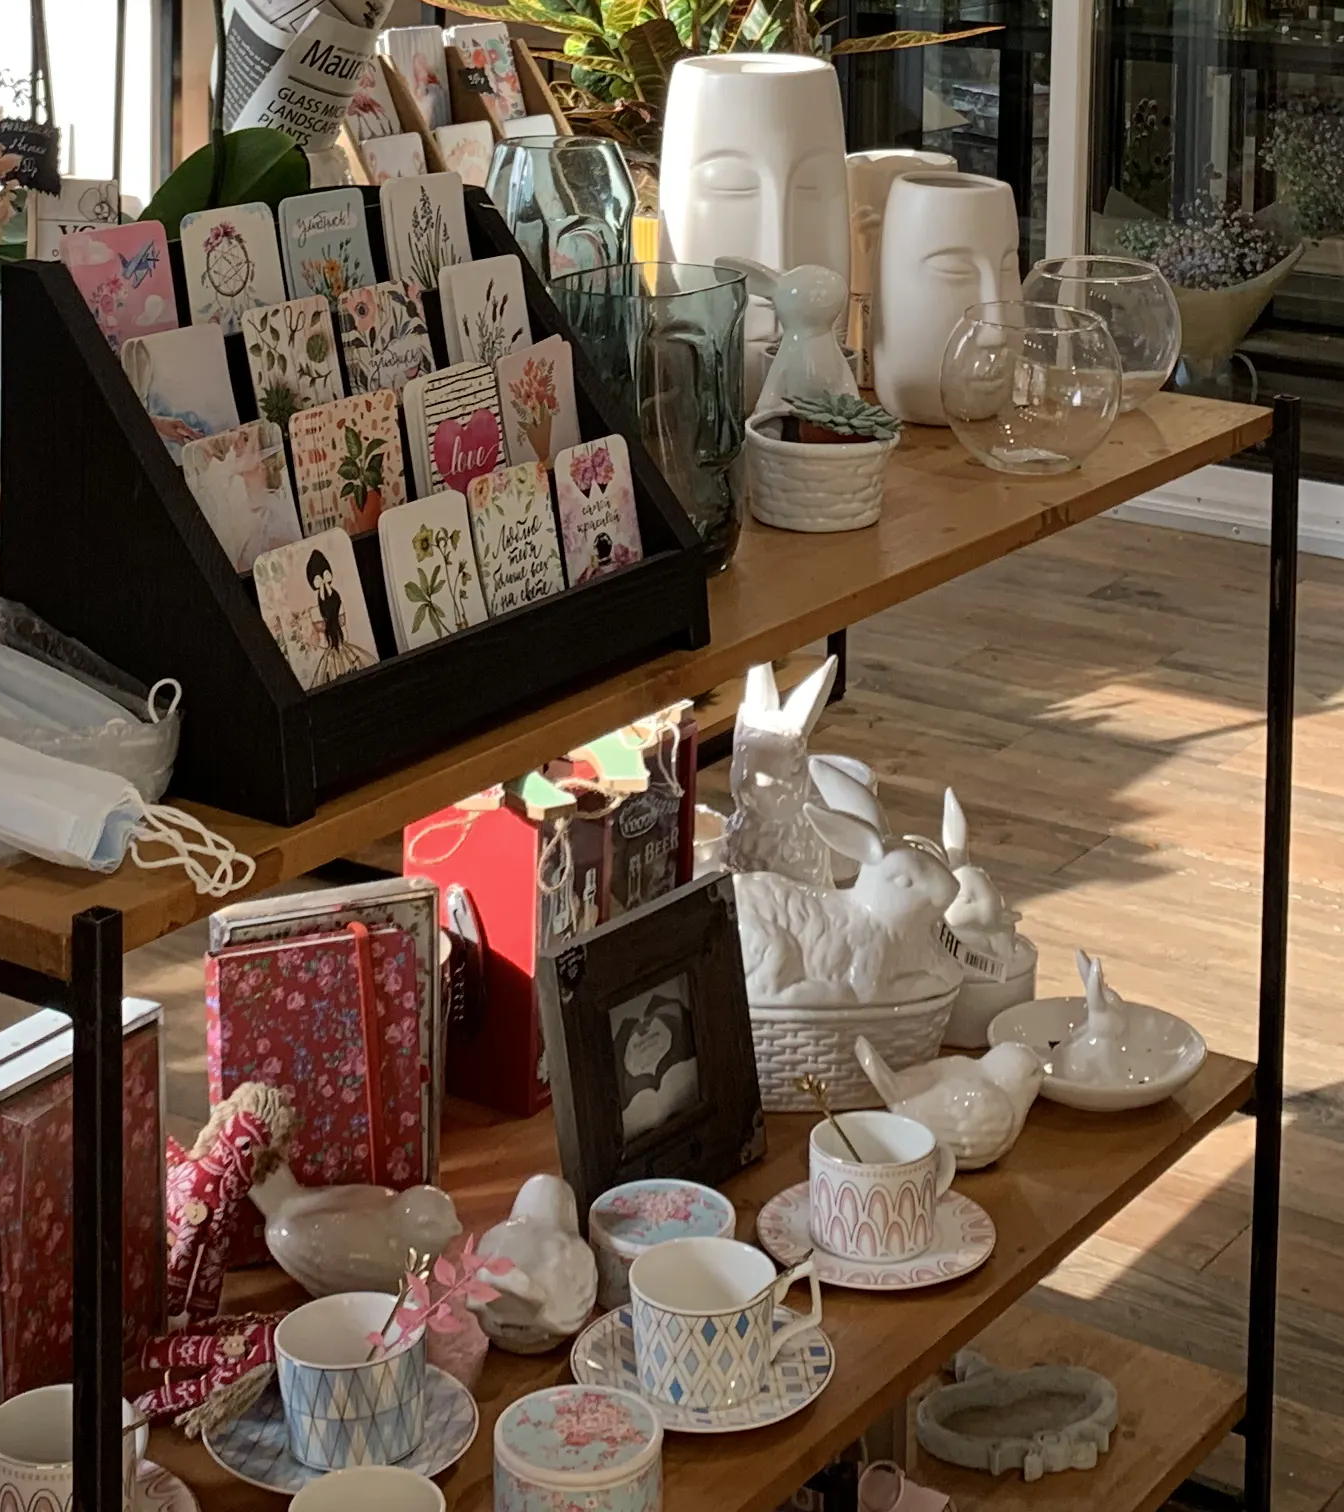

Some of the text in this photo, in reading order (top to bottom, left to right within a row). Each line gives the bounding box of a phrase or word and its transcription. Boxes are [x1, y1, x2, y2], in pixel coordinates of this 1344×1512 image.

[278, 87, 323, 113] GLASS
[445, 435, 498, 476] love
[492, 515, 542, 559] Люблю
[508, 540, 542, 565] тебя
[492, 564, 527, 593] больше
[520, 578, 552, 602] свете
[645, 826, 679, 864] BEER
